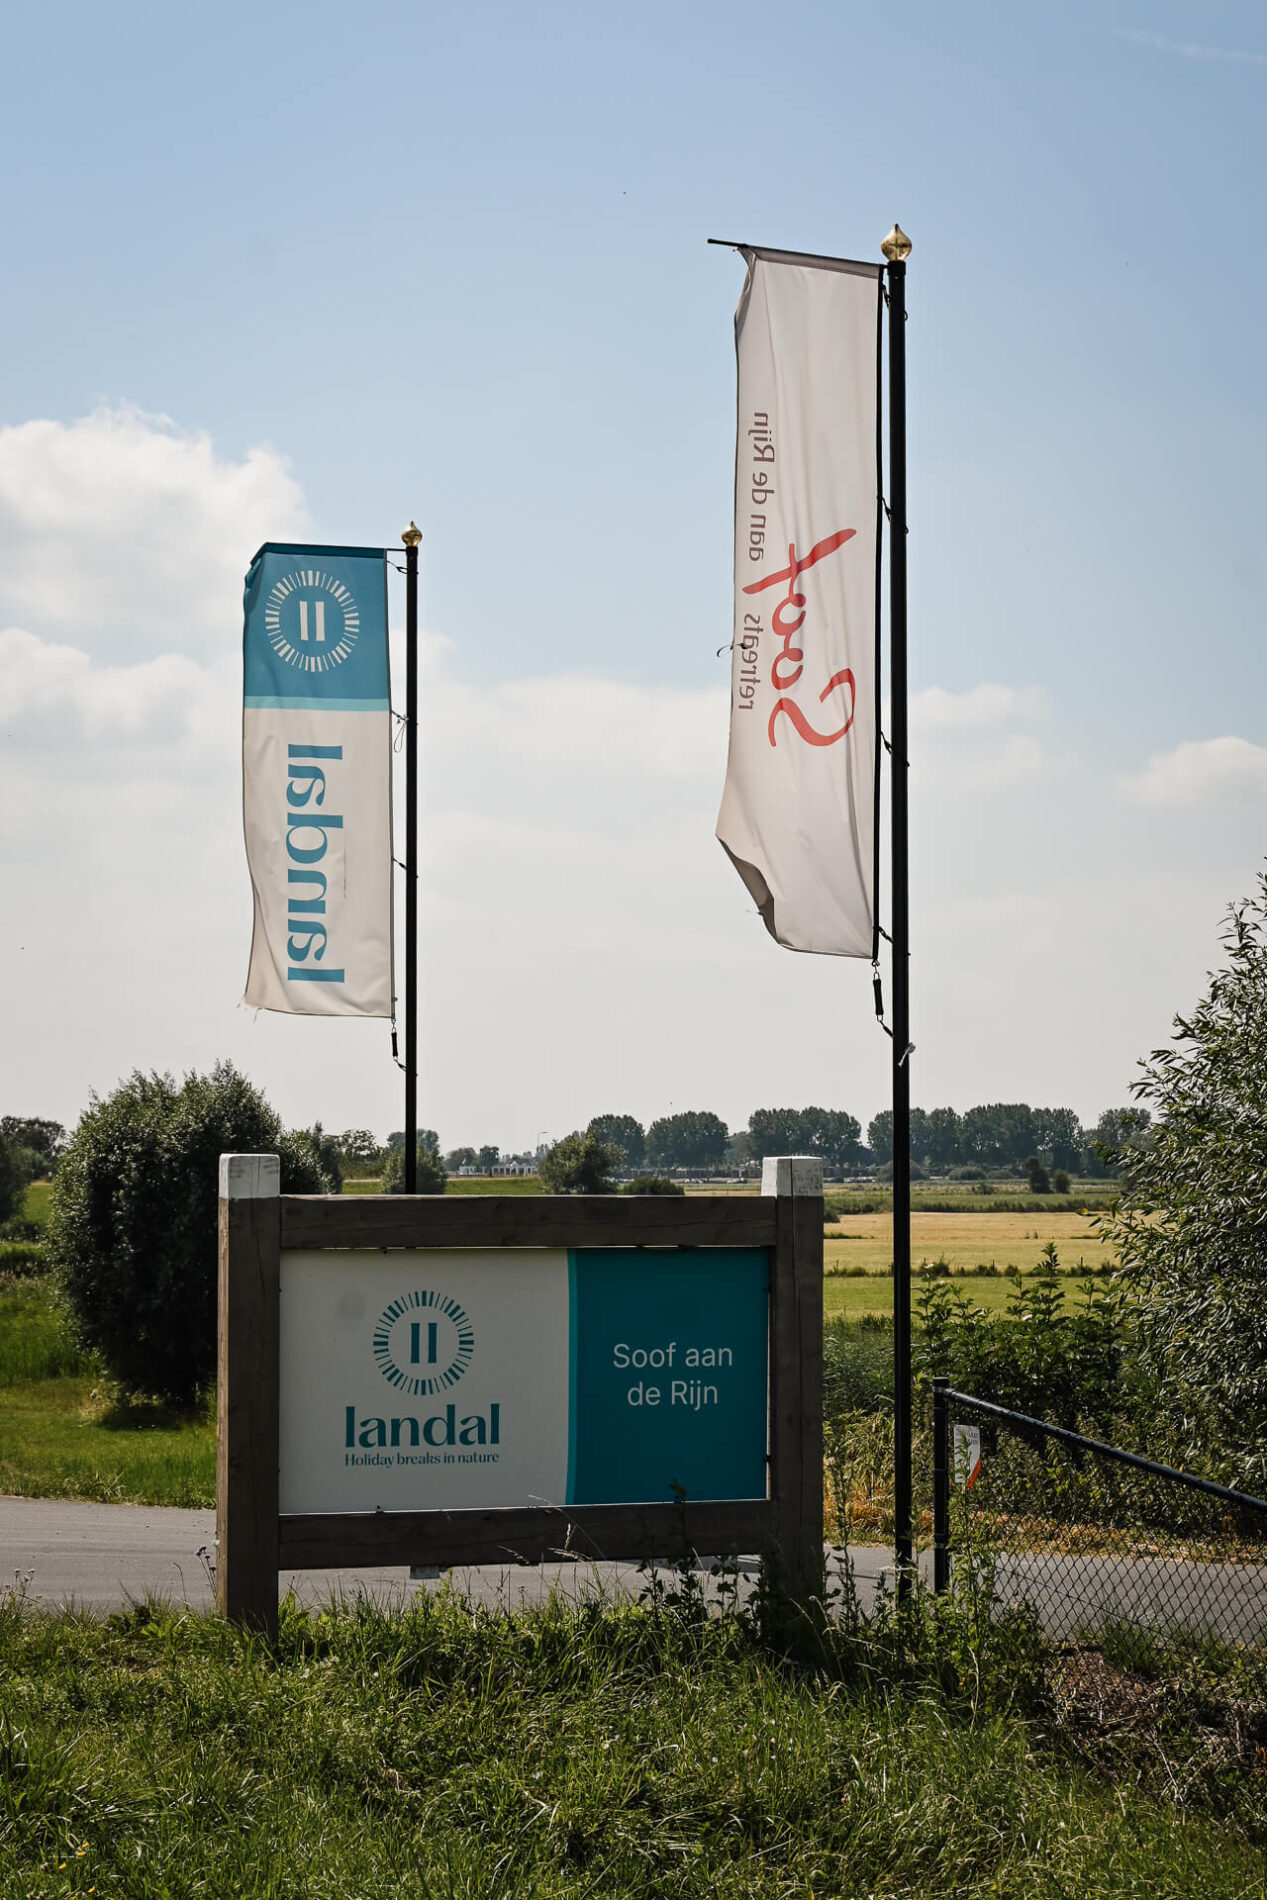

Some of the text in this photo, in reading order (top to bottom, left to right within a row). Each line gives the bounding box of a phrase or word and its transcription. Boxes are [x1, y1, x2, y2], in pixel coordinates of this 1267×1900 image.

[612, 1342, 733, 1369] Soof aan
[627, 1380, 718, 1411] de Rijn
[345, 1403, 500, 1449] landal
[345, 1452, 500, 1468] Holiday breaks in nature
